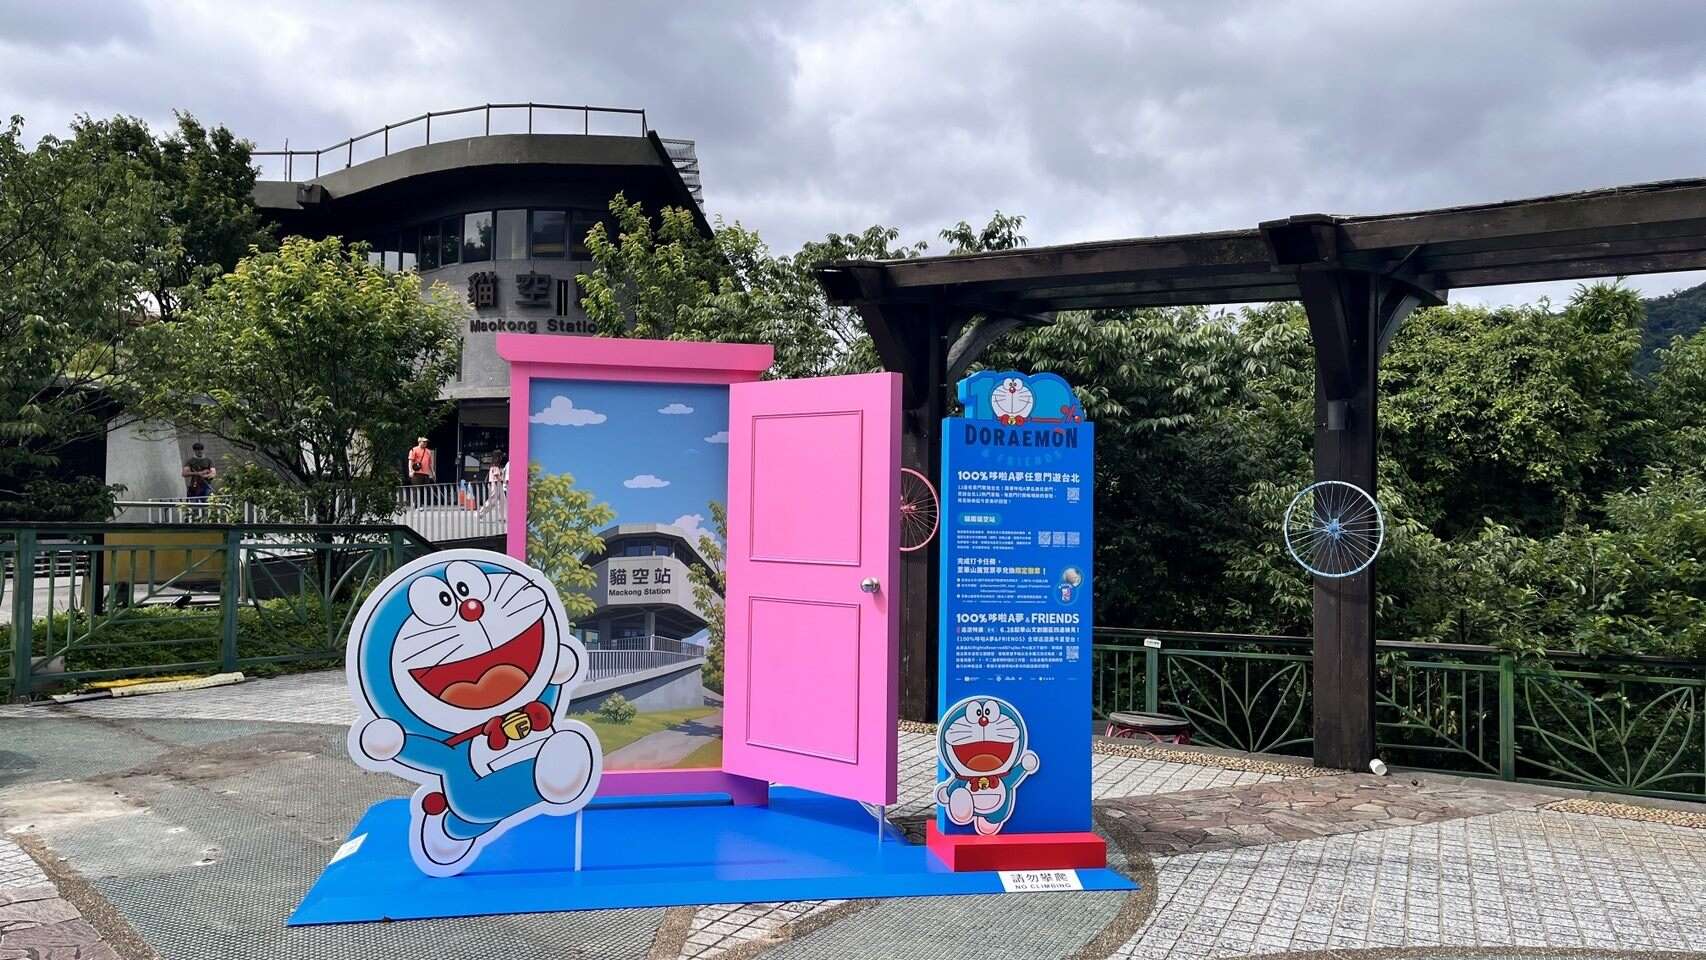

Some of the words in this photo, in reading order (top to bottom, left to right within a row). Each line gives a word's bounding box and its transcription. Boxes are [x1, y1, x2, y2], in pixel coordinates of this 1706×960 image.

[467, 271, 590, 311] 貓空
[547, 319, 599, 333] Statio
[965, 424, 1078, 449] DORAEMON
[610, 568, 671, 585] 貓空站
[1031, 613, 1080, 624] FRIENDS
